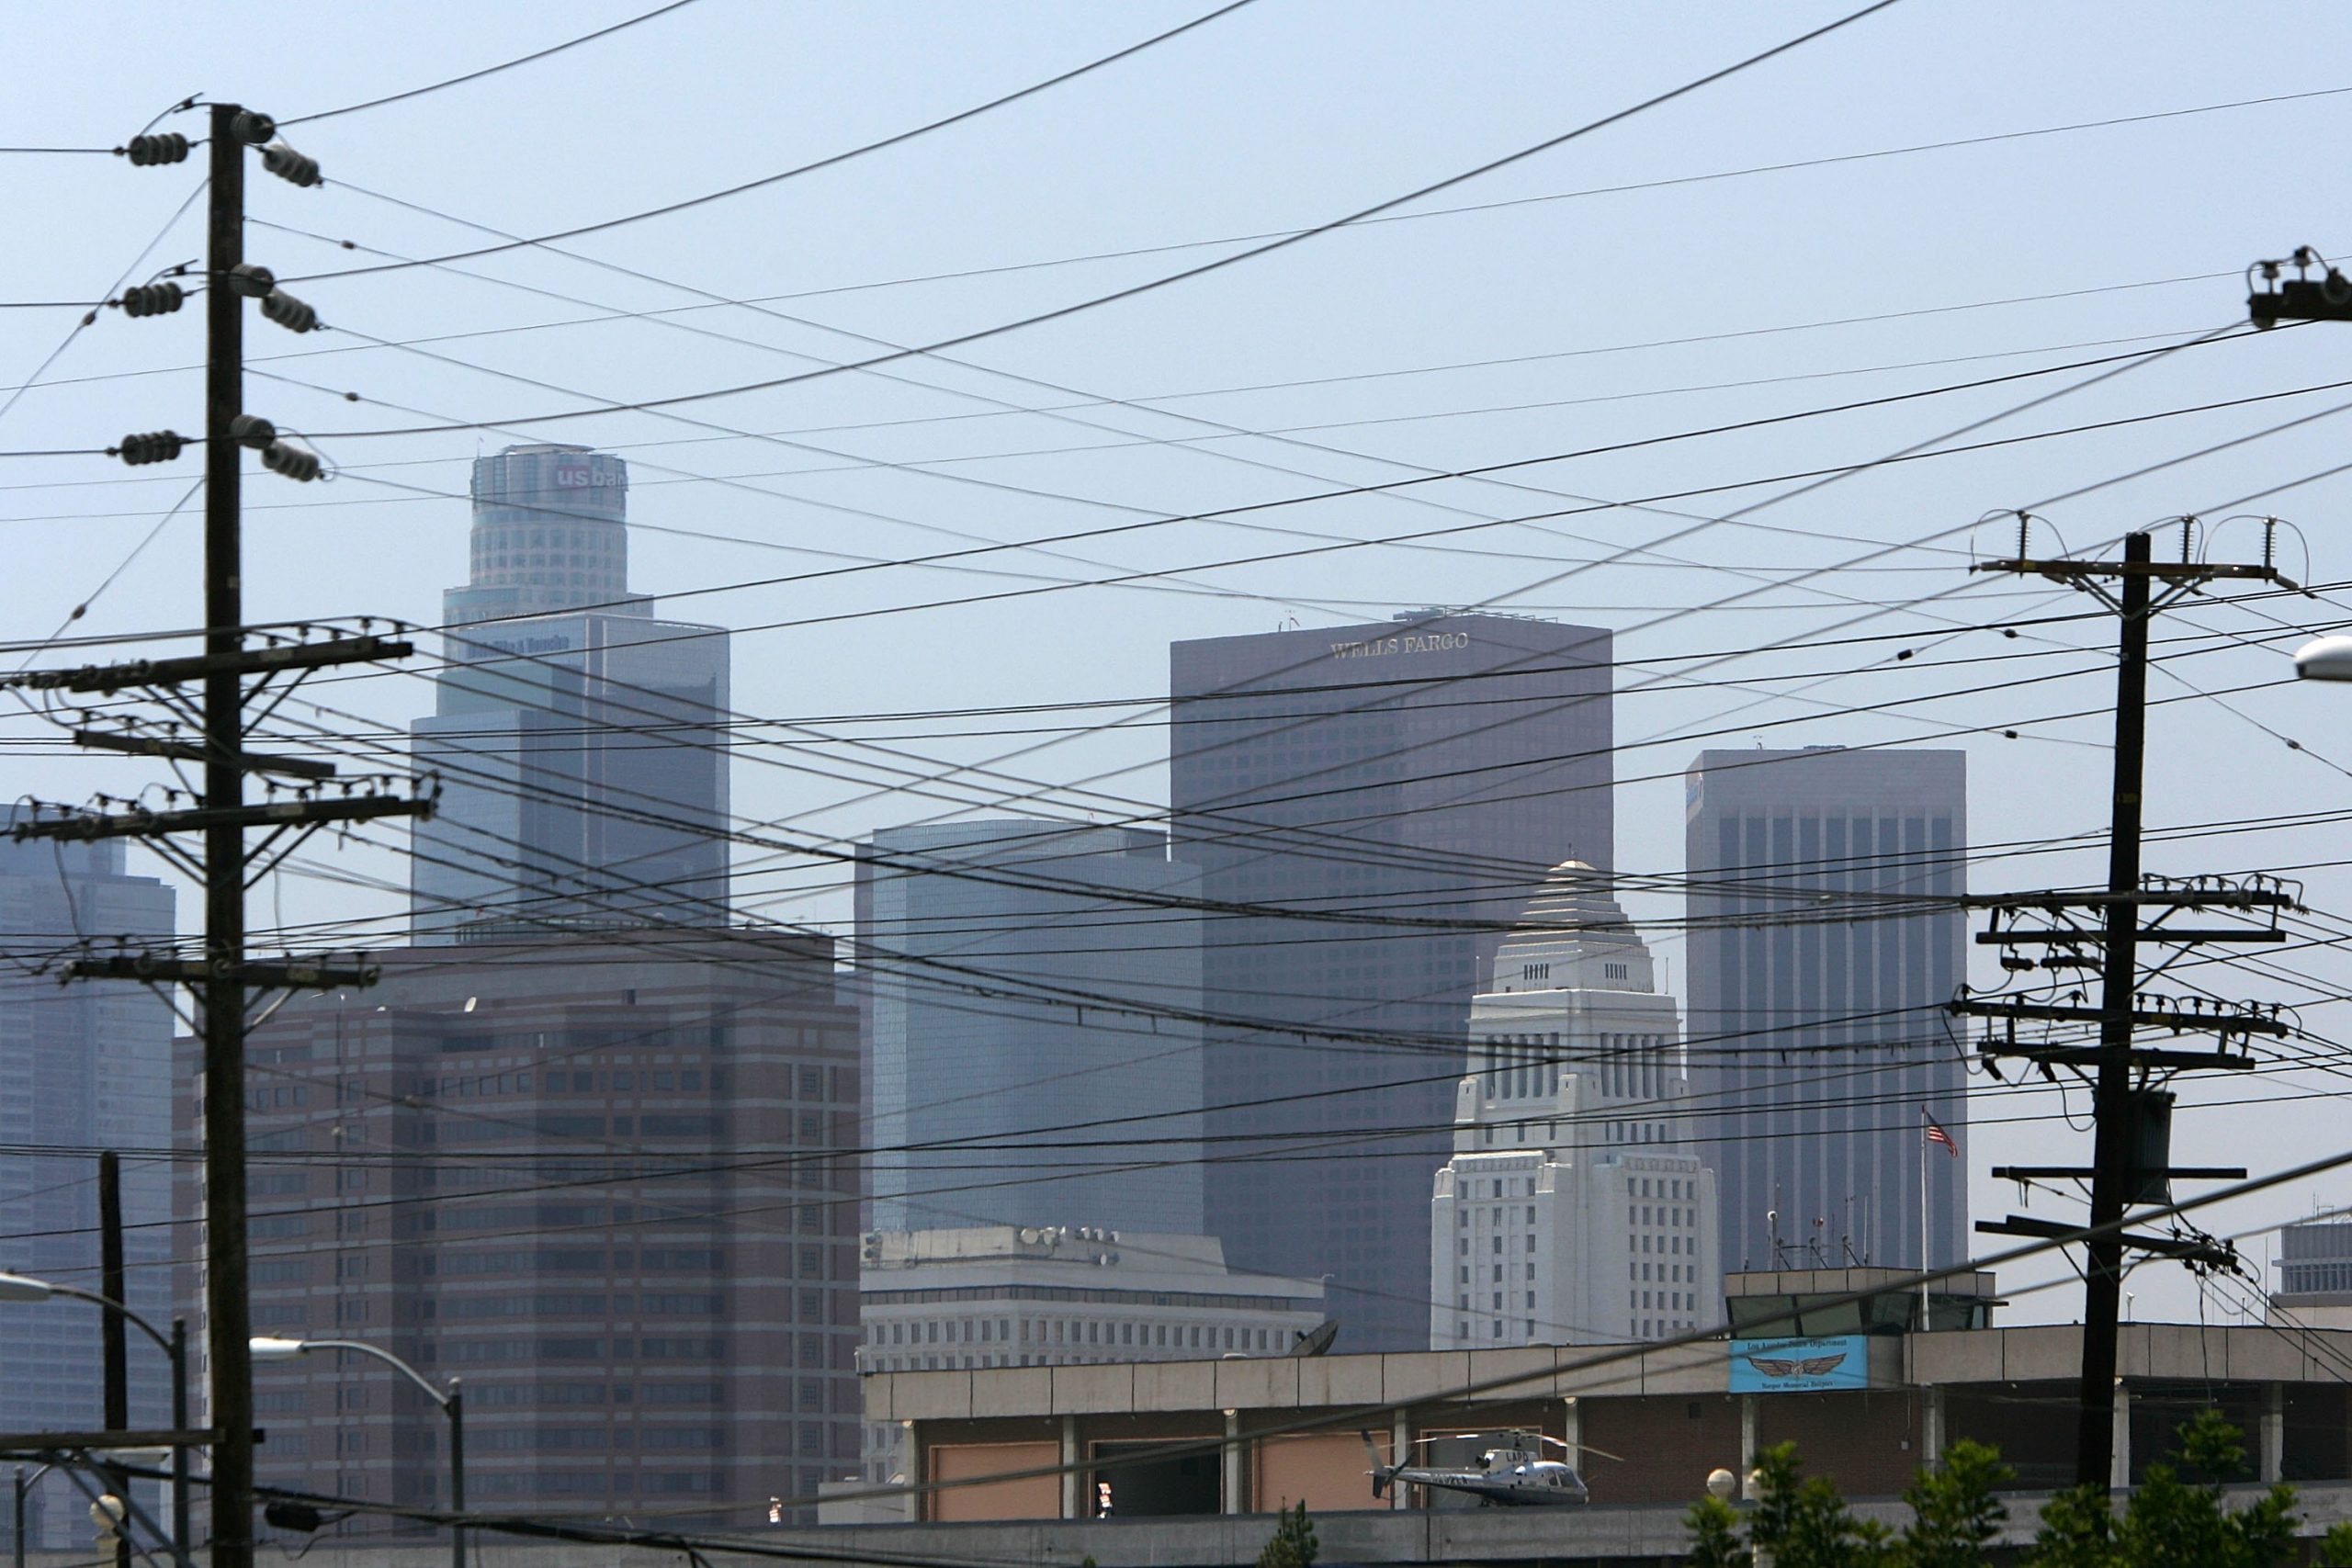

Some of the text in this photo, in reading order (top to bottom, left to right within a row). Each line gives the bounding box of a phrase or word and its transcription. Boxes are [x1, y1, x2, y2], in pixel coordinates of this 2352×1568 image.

[1331, 632, 1469, 660] WELLS FARGO
[1506, 1451, 1529, 1462] LAPD
